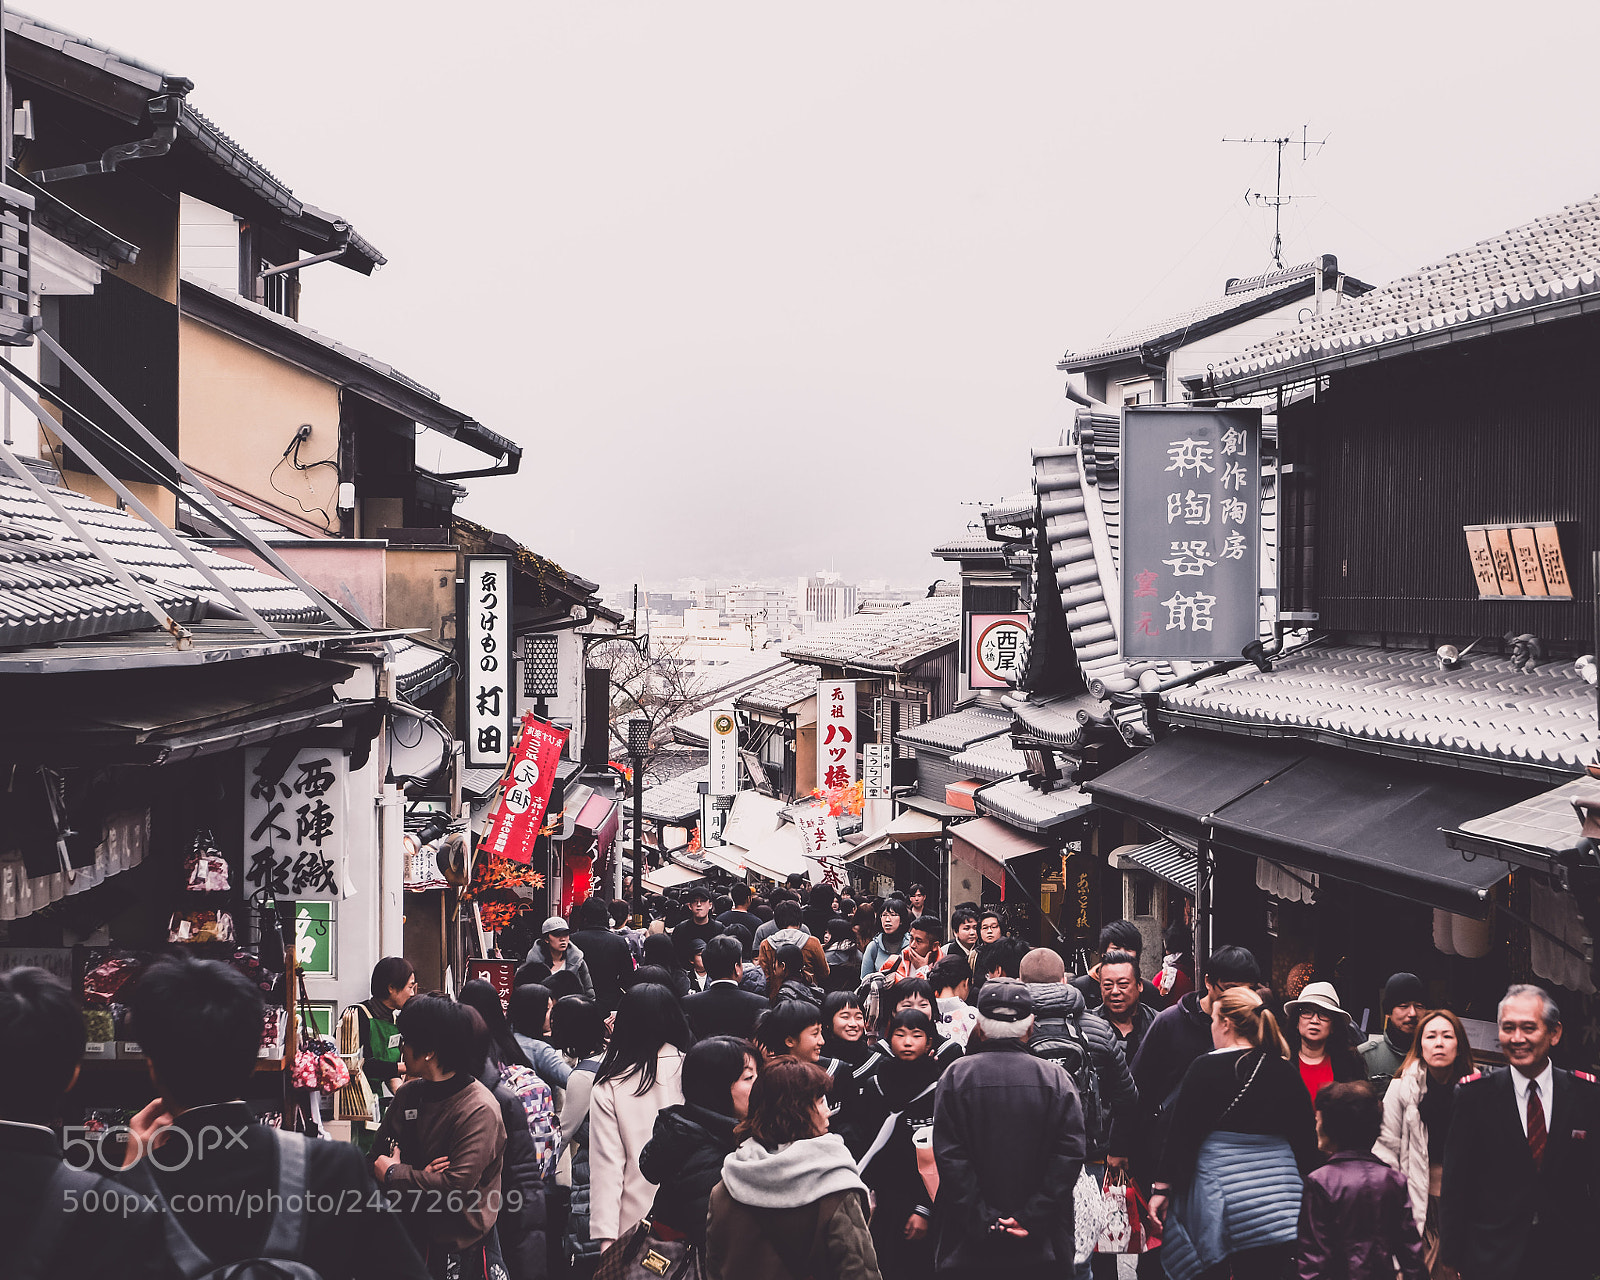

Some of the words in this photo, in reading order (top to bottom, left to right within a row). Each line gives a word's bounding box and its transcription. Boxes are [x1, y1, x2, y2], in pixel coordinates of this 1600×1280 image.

[1160, 437, 1217, 632] 森陶器館
[1219, 426, 1248, 560] 創作陶房
[480, 571, 498, 672] 京つけもの
[1133, 568, 1160, 637] 窯元
[994, 631, 1018, 671] 西尾
[475, 685, 503, 753] 打田
[830, 687, 845, 719] 元祖
[292, 757, 338, 896] 西陣織
